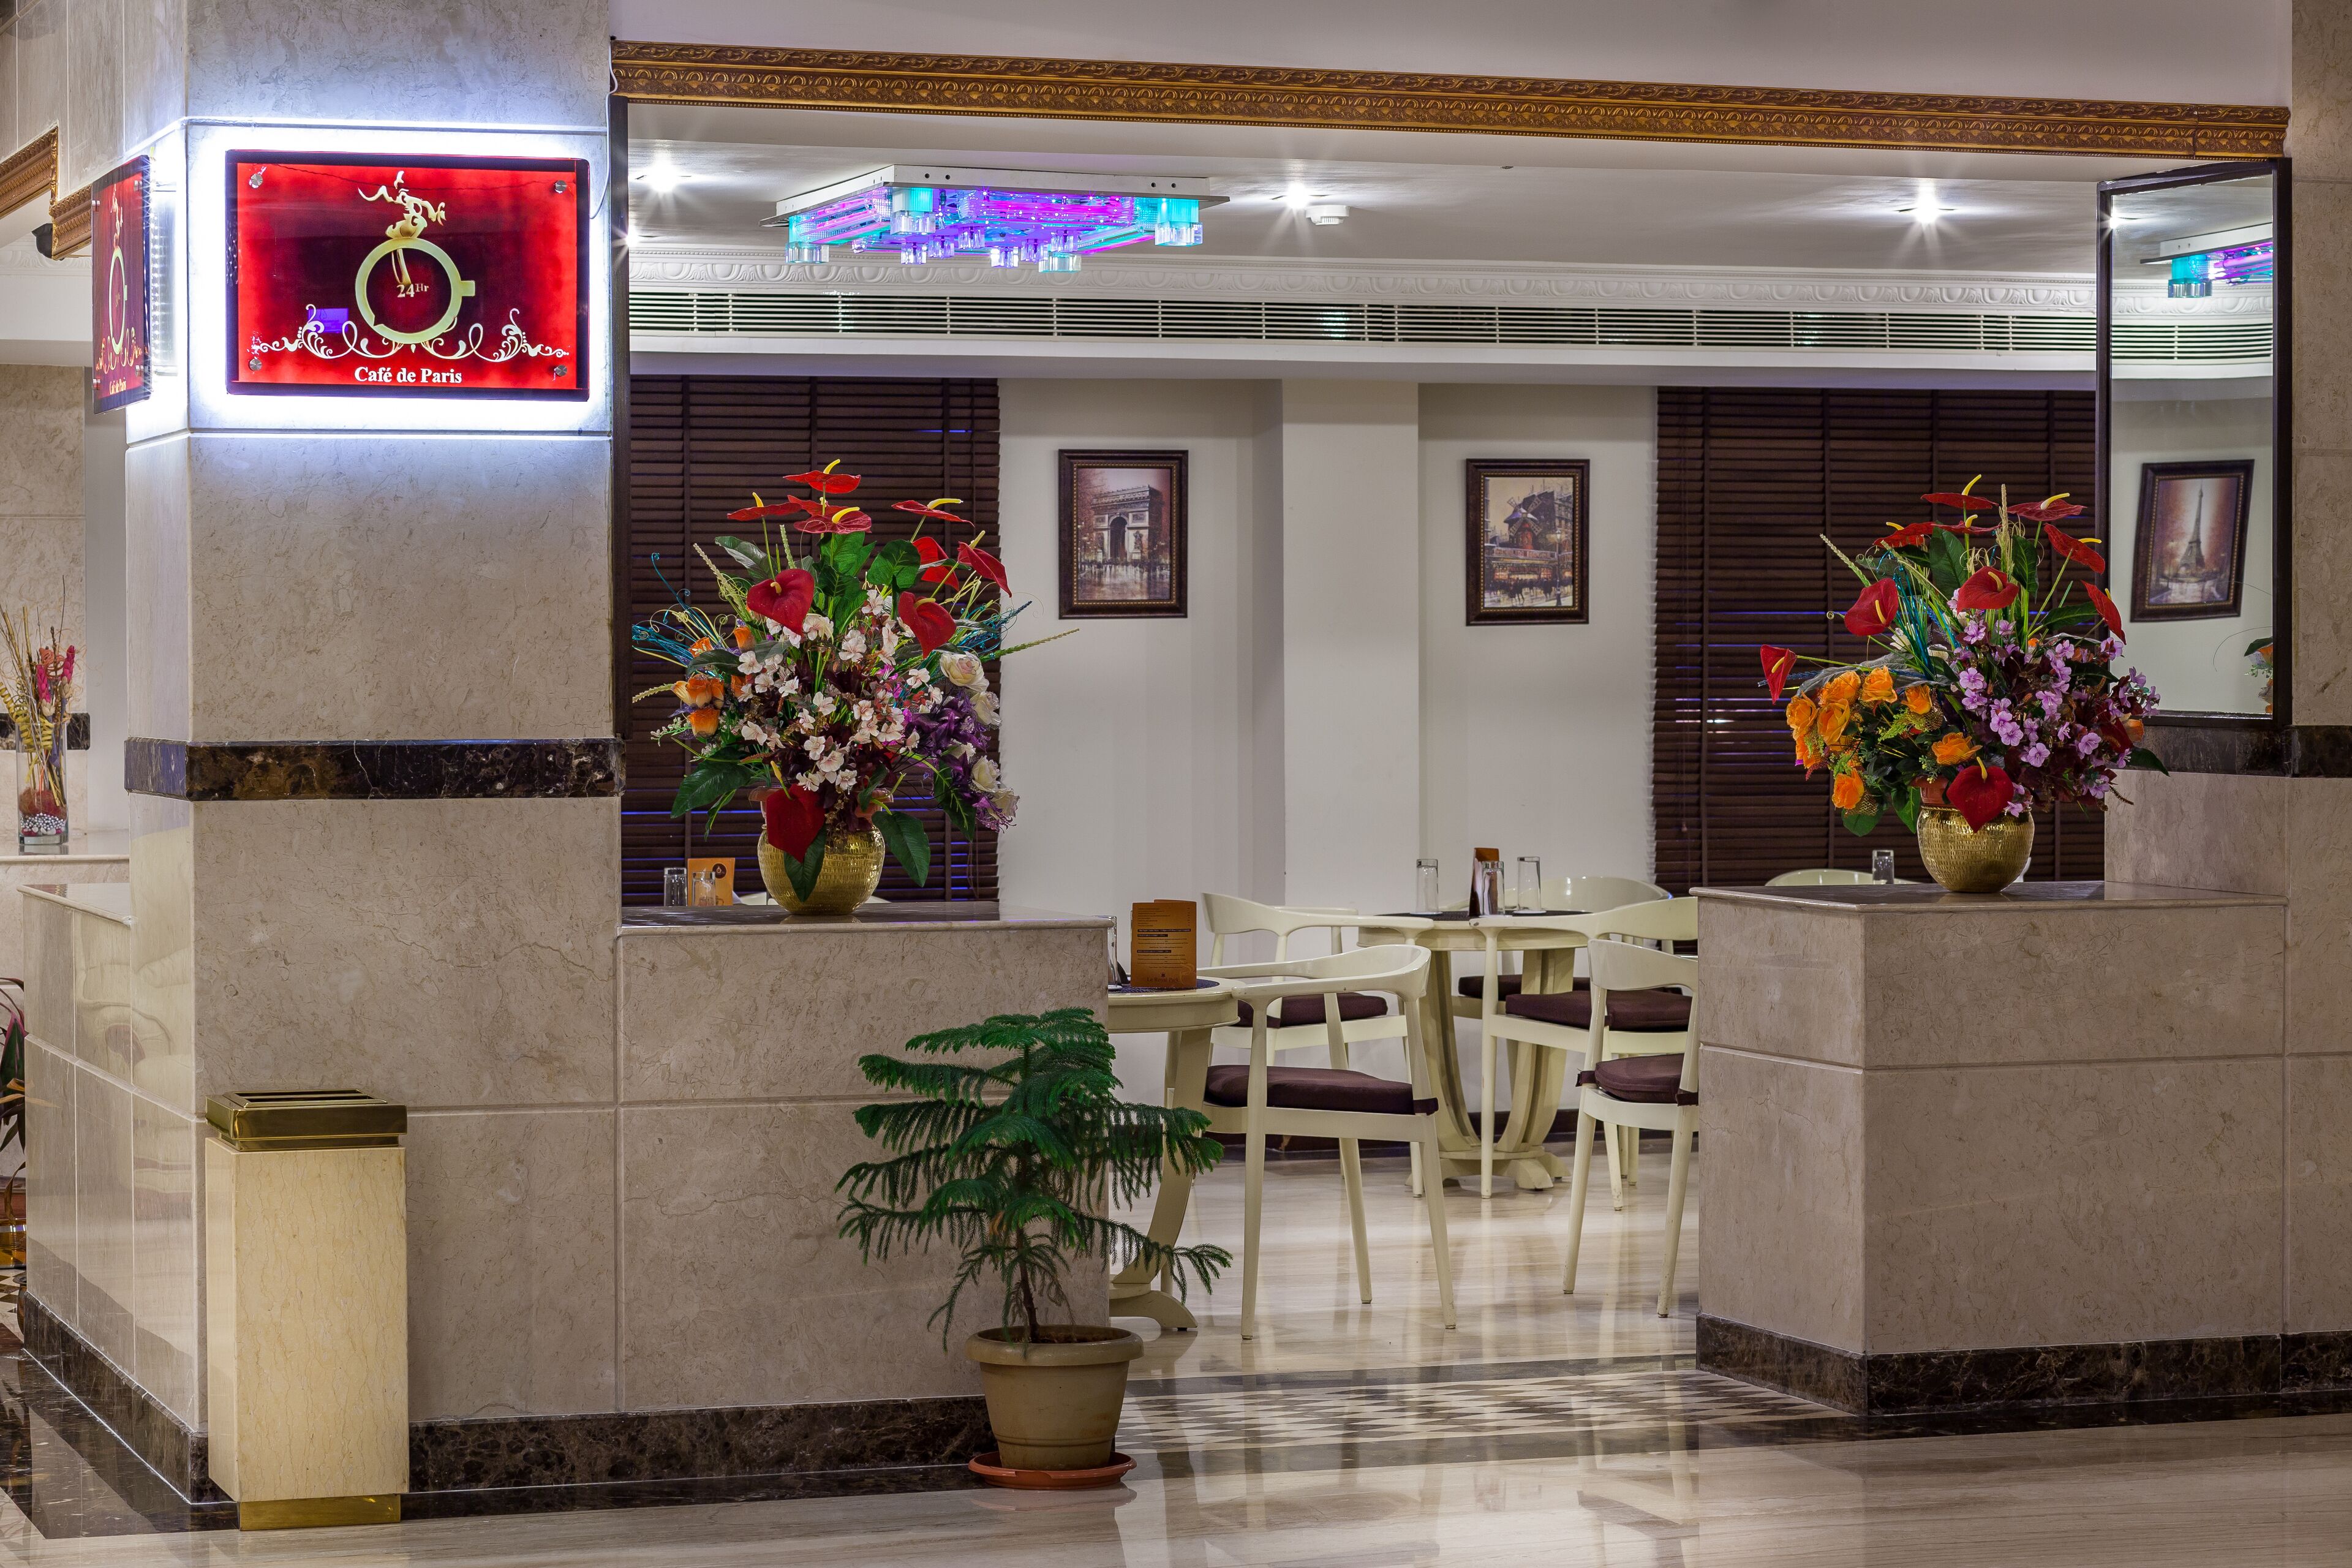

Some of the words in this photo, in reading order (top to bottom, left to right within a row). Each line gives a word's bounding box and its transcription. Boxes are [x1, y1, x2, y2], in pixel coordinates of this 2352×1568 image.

[354, 366, 393, 383] Café
[396, 368, 416, 383] de
[420, 368, 462, 383] Paris
